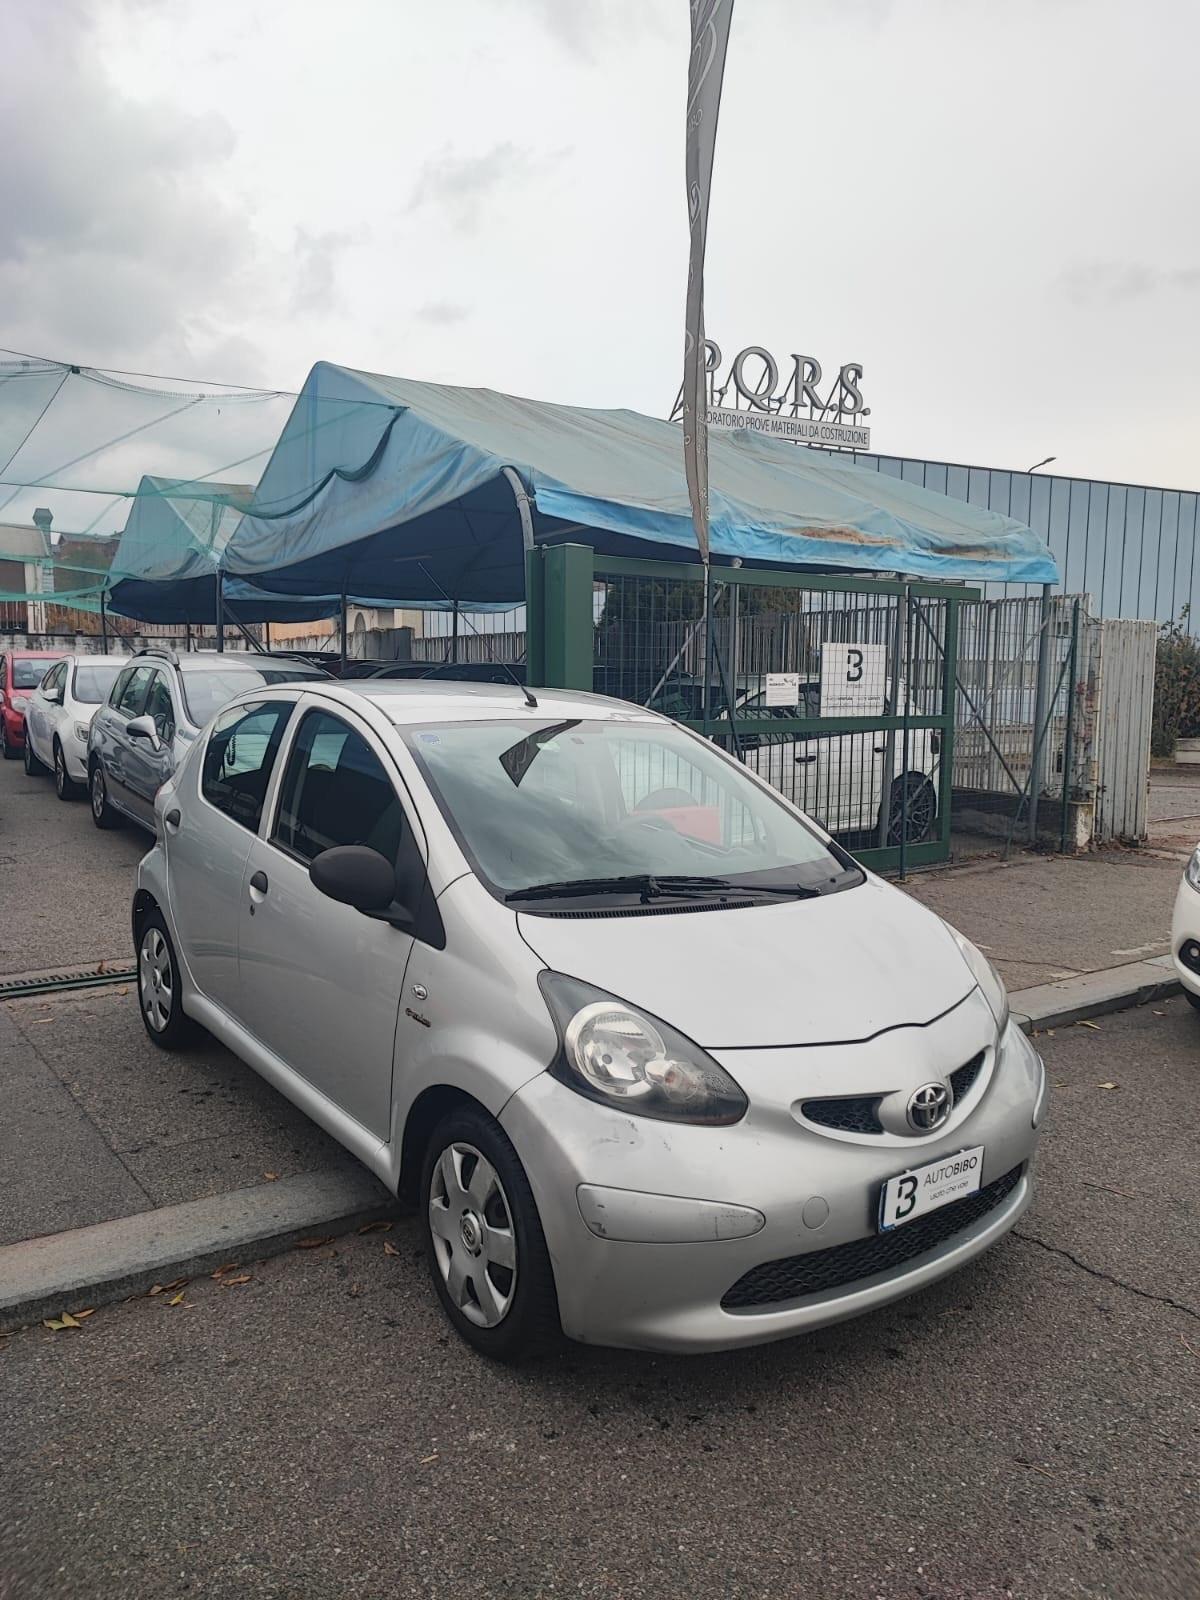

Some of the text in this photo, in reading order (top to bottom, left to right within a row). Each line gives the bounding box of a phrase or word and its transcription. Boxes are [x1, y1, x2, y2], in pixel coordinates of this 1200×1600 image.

[706, 411, 868, 445] ORATORIO PROVE MATERIALI DA COSTRUZIONE
[923, 1156, 978, 1188] AUTOBIBO
